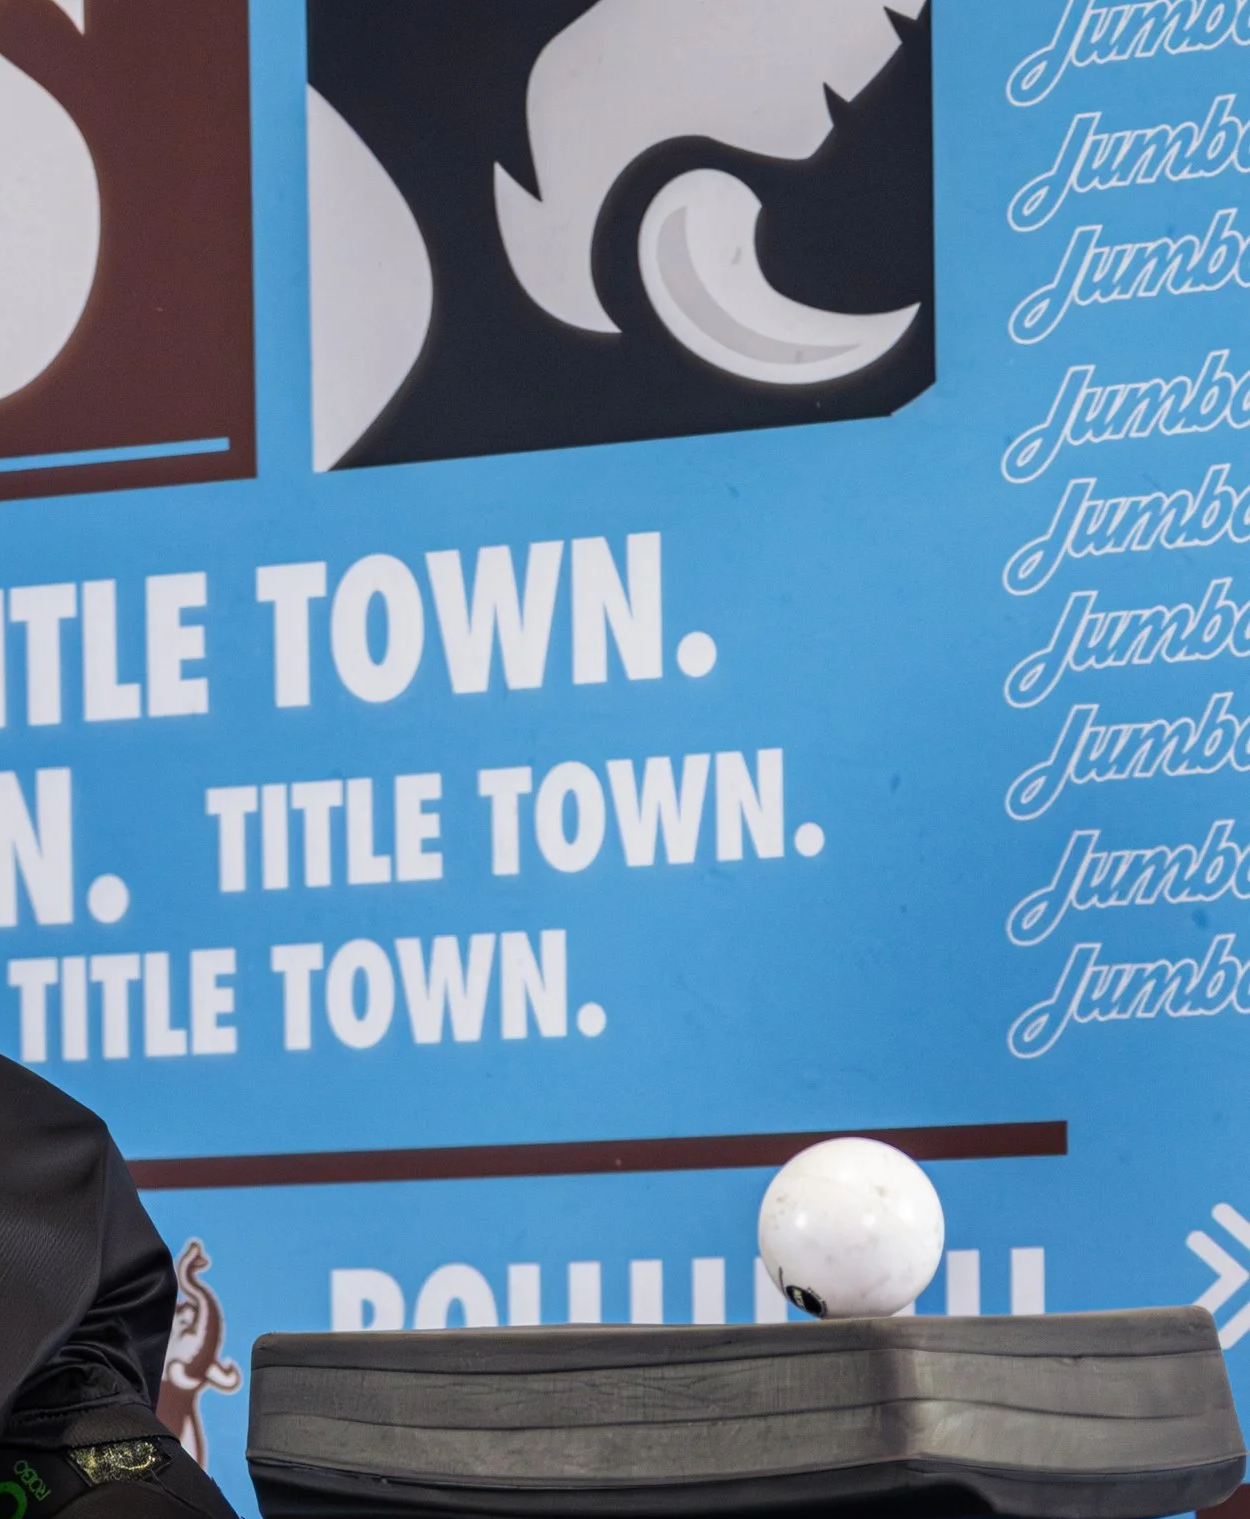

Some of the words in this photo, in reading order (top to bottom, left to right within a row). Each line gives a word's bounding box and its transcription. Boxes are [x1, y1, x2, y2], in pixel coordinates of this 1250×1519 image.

[255, 531, 718, 709] TOWN.
[206, 772, 444, 893] TITLE
[477, 747, 825, 877] TOWN.
[8, 947, 238, 1063] TITLE
[270, 928, 607, 1051] TOWN.
